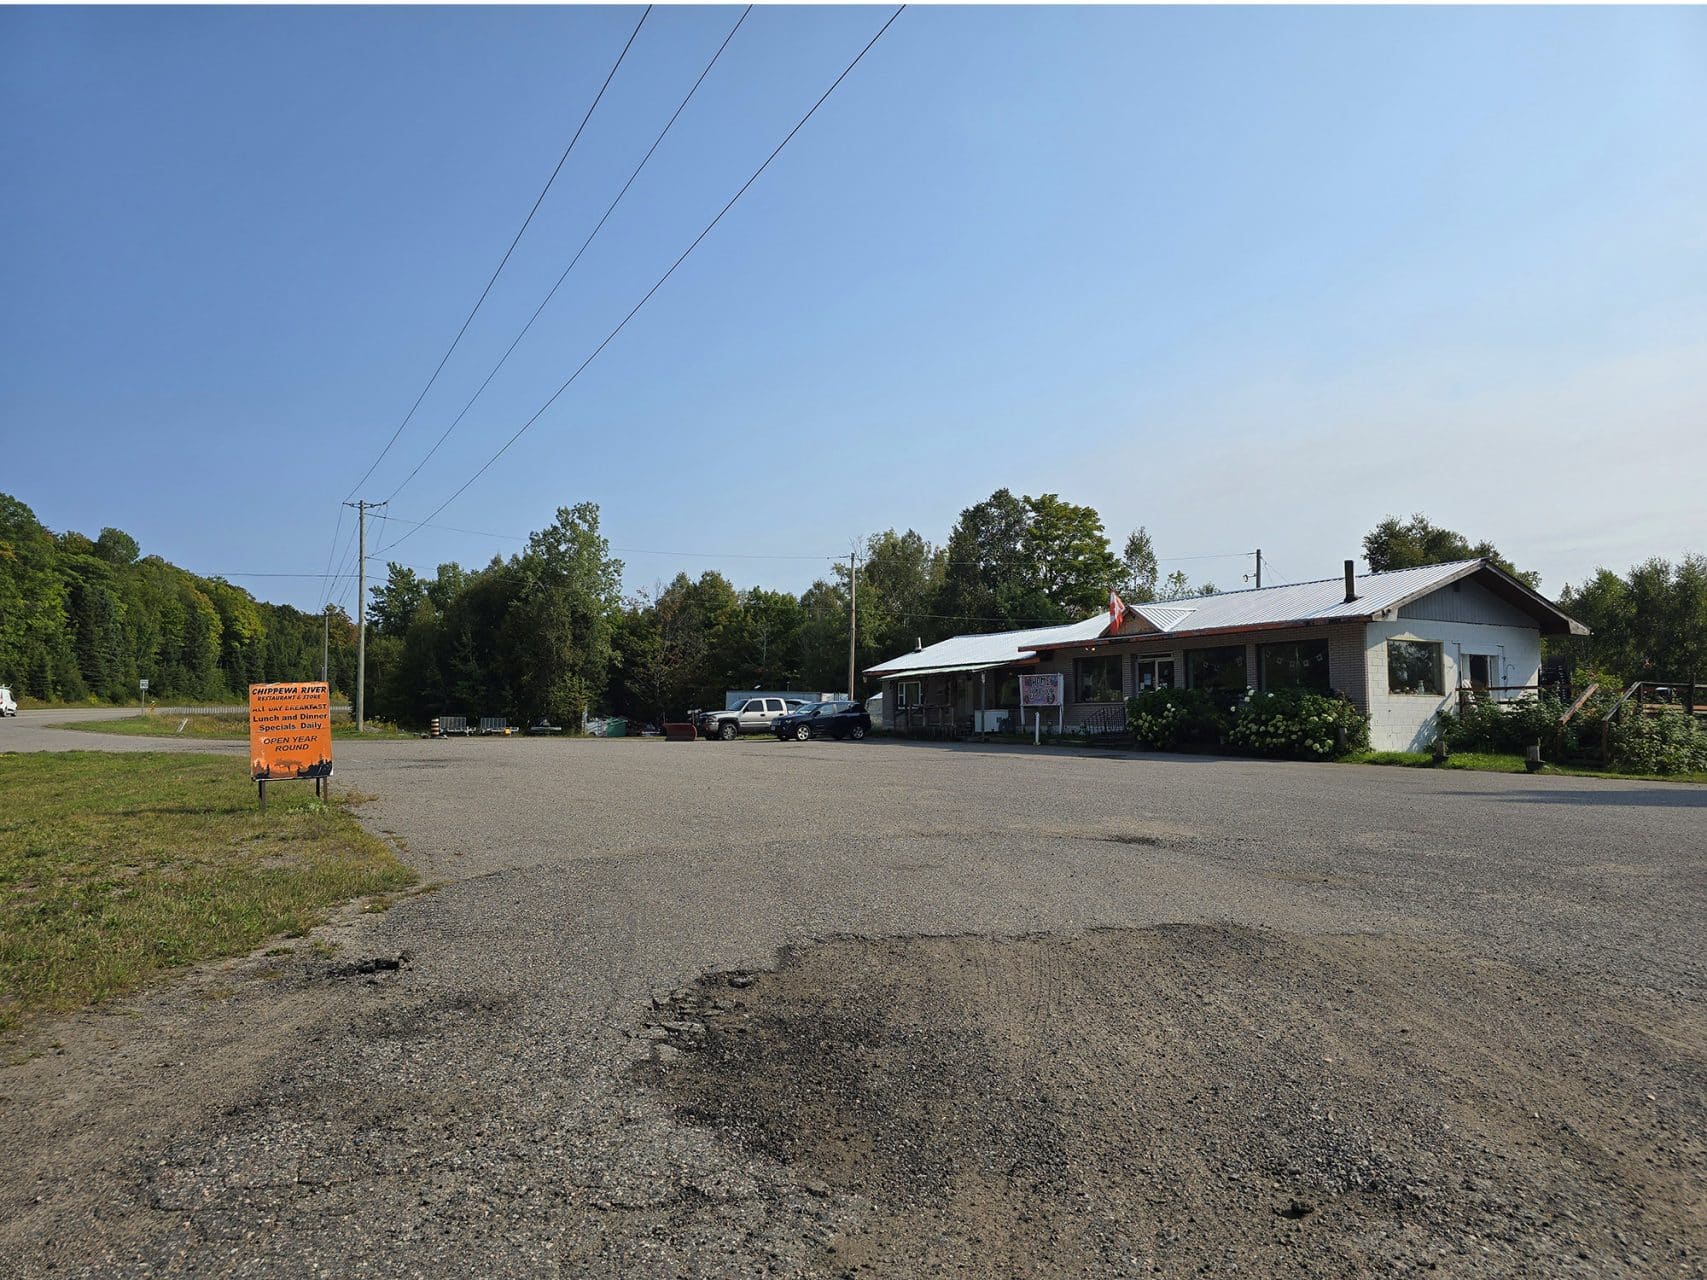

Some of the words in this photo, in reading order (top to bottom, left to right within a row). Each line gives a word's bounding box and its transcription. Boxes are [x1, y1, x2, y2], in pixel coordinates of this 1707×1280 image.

[252, 687, 297, 695] CHIPPEWA
[253, 714, 280, 723] Lunch
[282, 713, 298, 721] and
[300, 712, 328, 720] Dinner
[259, 723, 296, 732] Specials
[300, 721, 322, 730] Daily
[263, 737, 290, 745] OPEN
[292, 735, 318, 743] YEAR
[275, 743, 310, 752] ROUND
